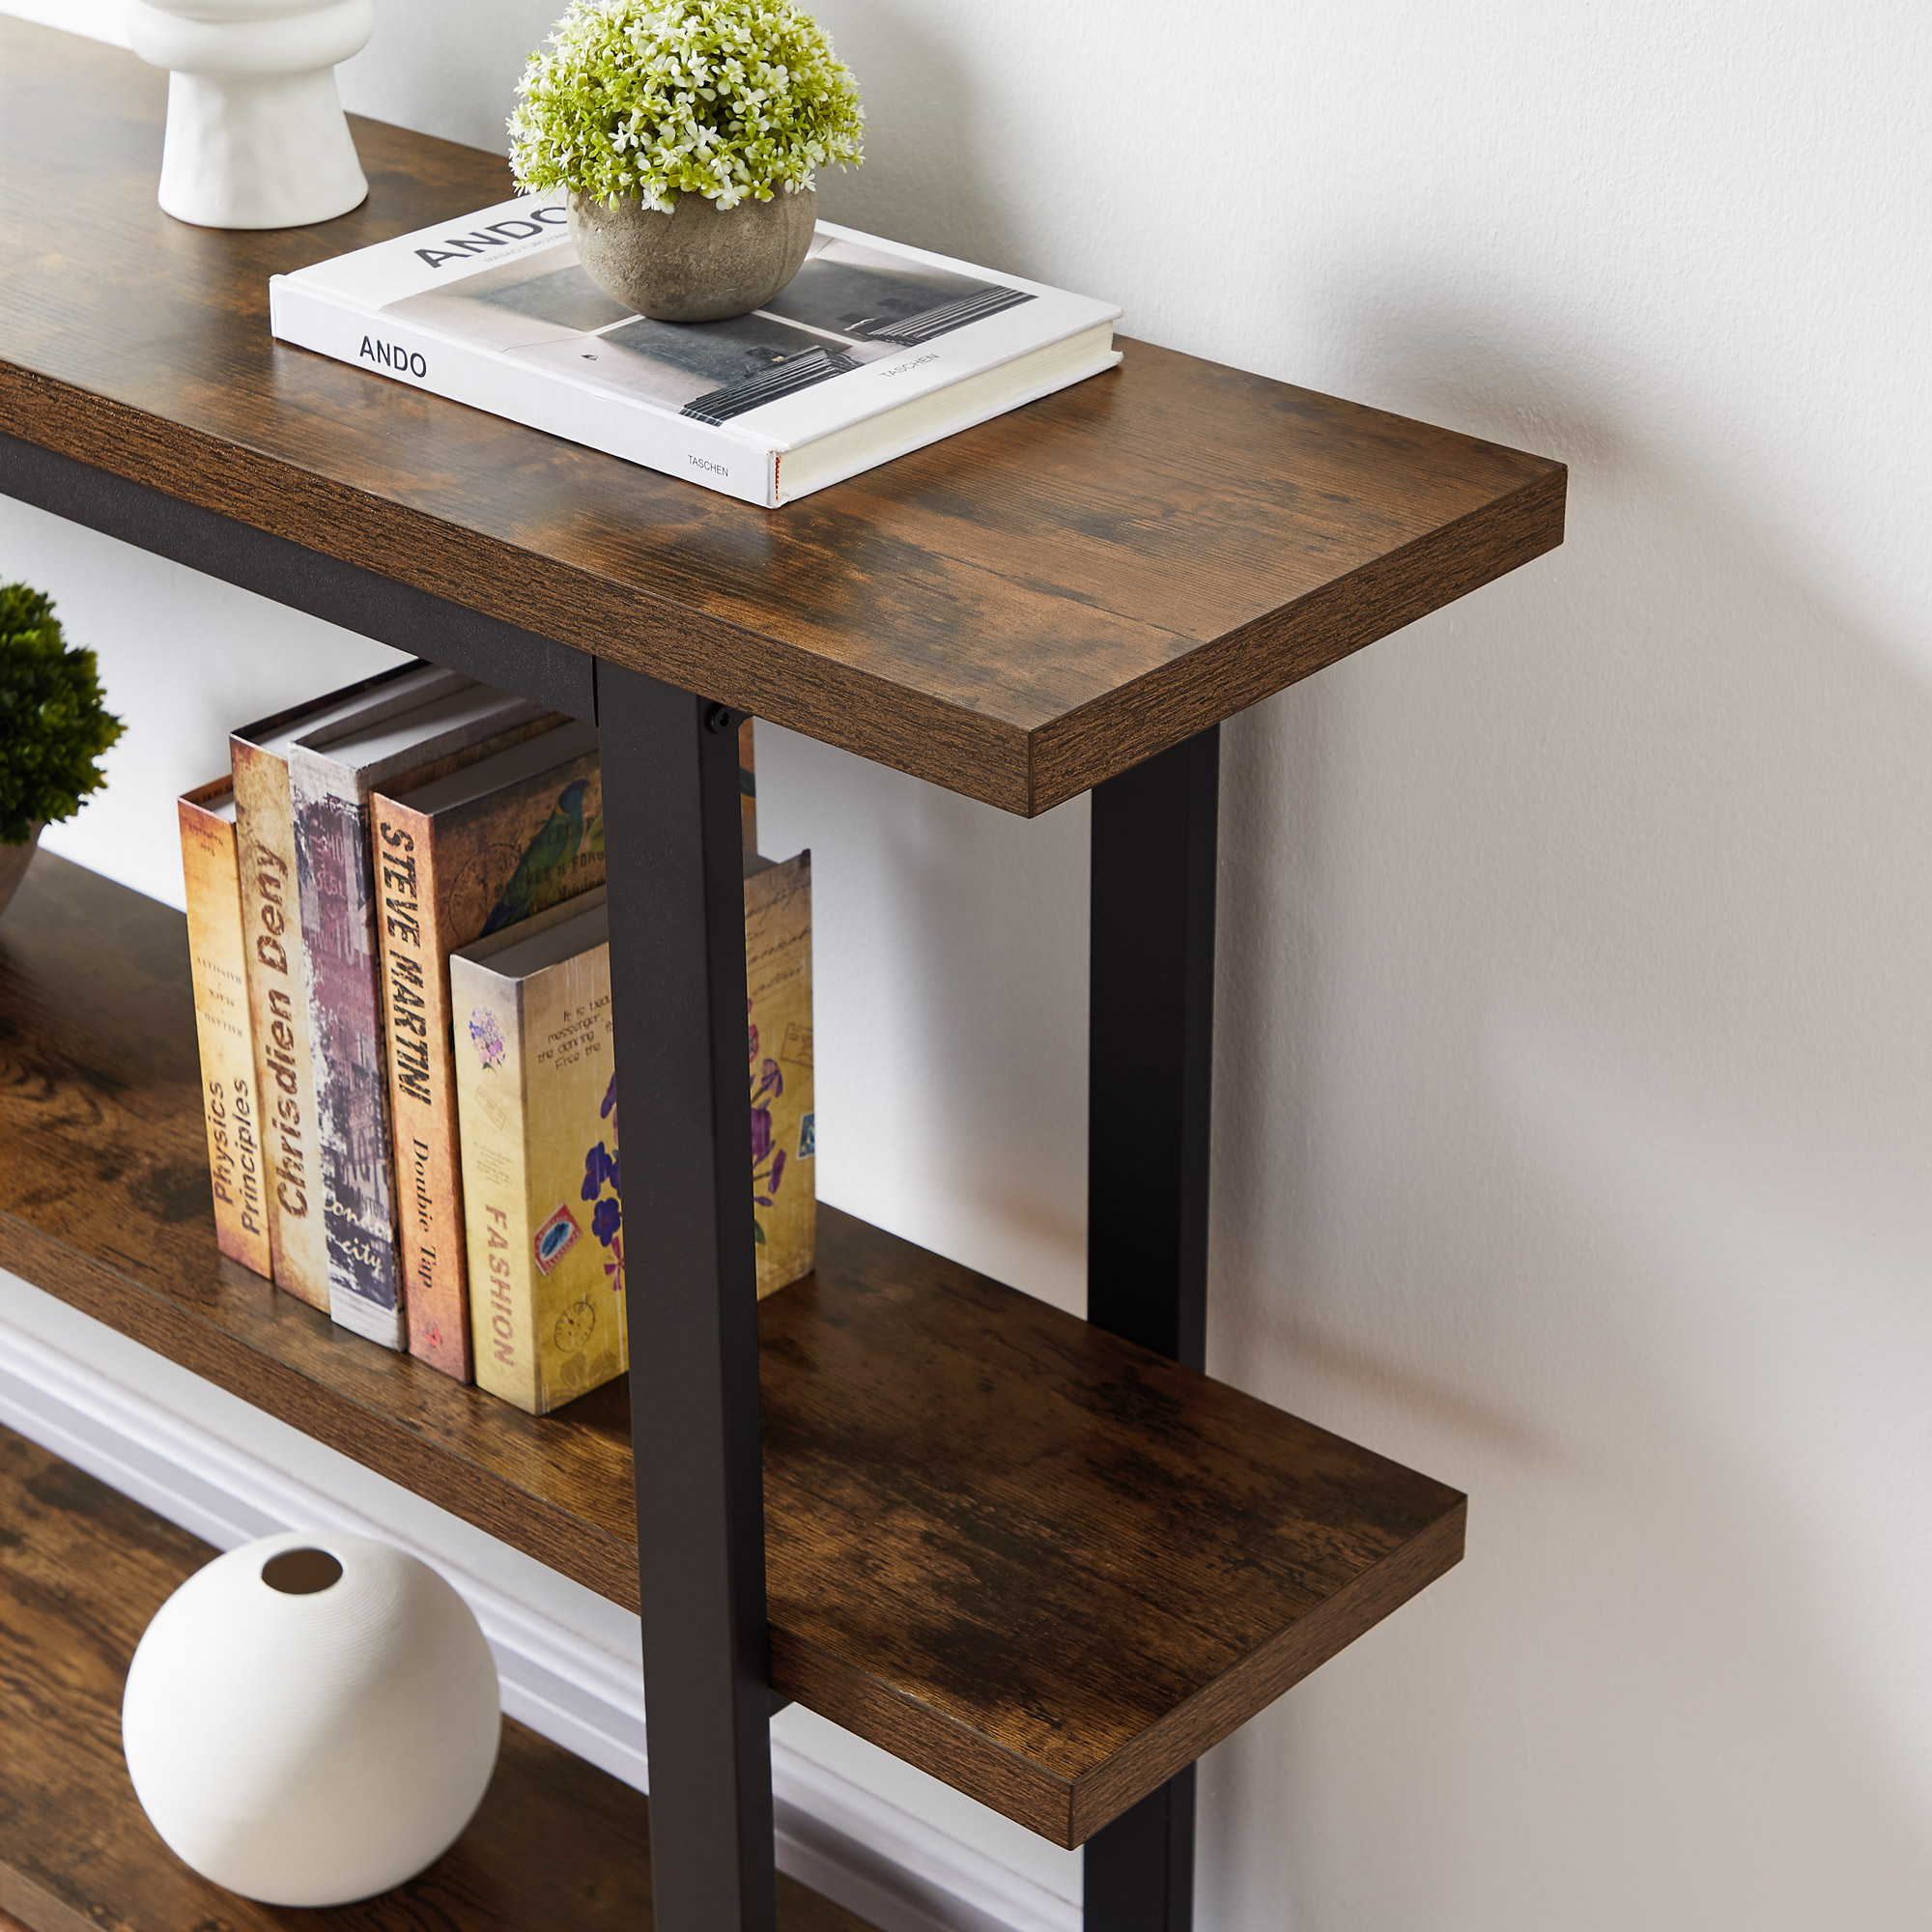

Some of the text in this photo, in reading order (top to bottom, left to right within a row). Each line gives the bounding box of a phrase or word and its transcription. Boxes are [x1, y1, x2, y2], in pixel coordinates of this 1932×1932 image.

[414, 207, 567, 269] ANDO
[359, 335, 427, 378] ANDO
[879, 354, 940, 377] TASCHEN
[687, 454, 728, 477] TASCHEN
[380, 822, 432, 1106] STEVE MARTINI
[255, 839, 308, 1219] Chrisdien Deny
[208, 1080, 234, 1206] Physics
[233, 1078, 261, 1236] Principles
[417, 1245, 436, 1289] Tap
[485, 1204, 515, 1367] FASHION
